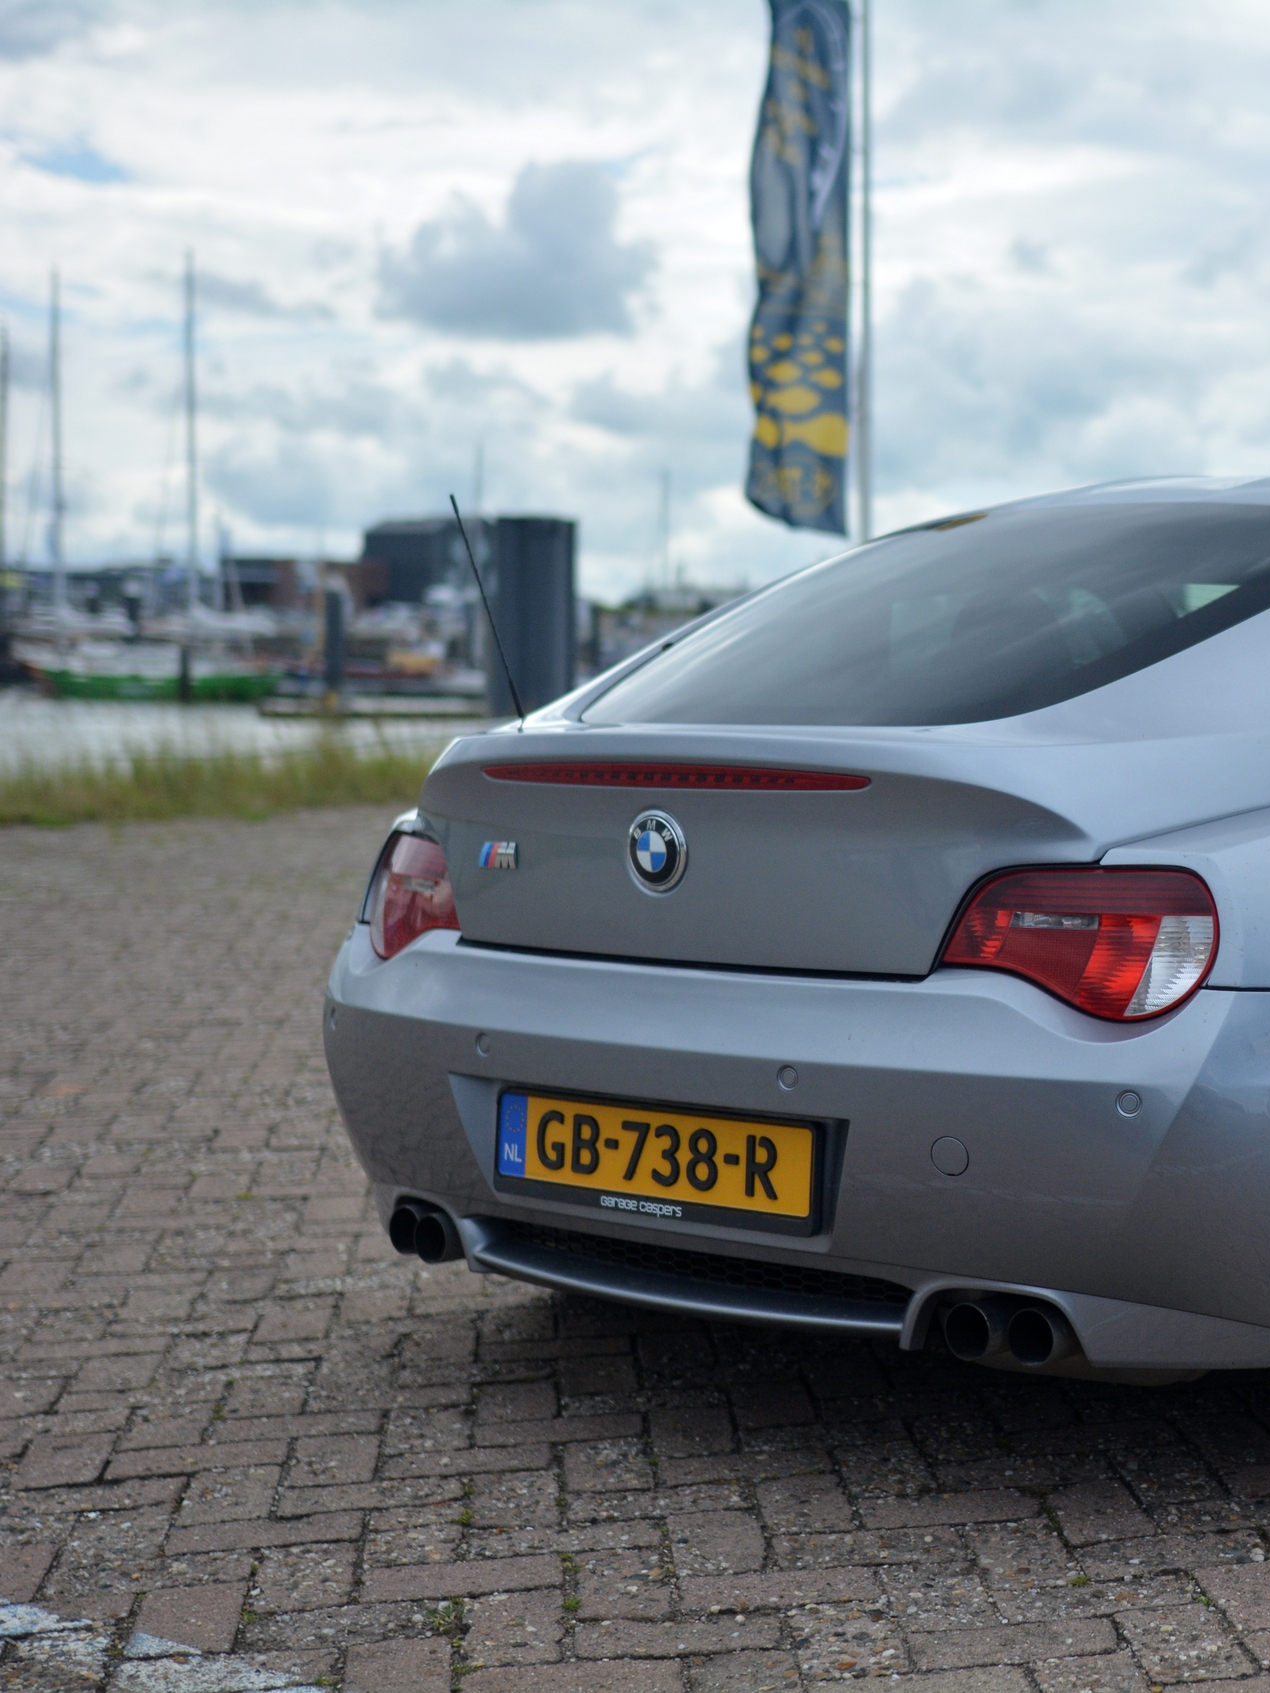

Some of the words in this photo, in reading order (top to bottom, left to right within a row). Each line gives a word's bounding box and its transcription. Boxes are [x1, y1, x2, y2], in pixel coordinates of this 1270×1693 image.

[632, 818, 673, 841] BMW
[503, 1142, 523, 1163] NL
[536, 1110, 778, 1200] GB-738-R
